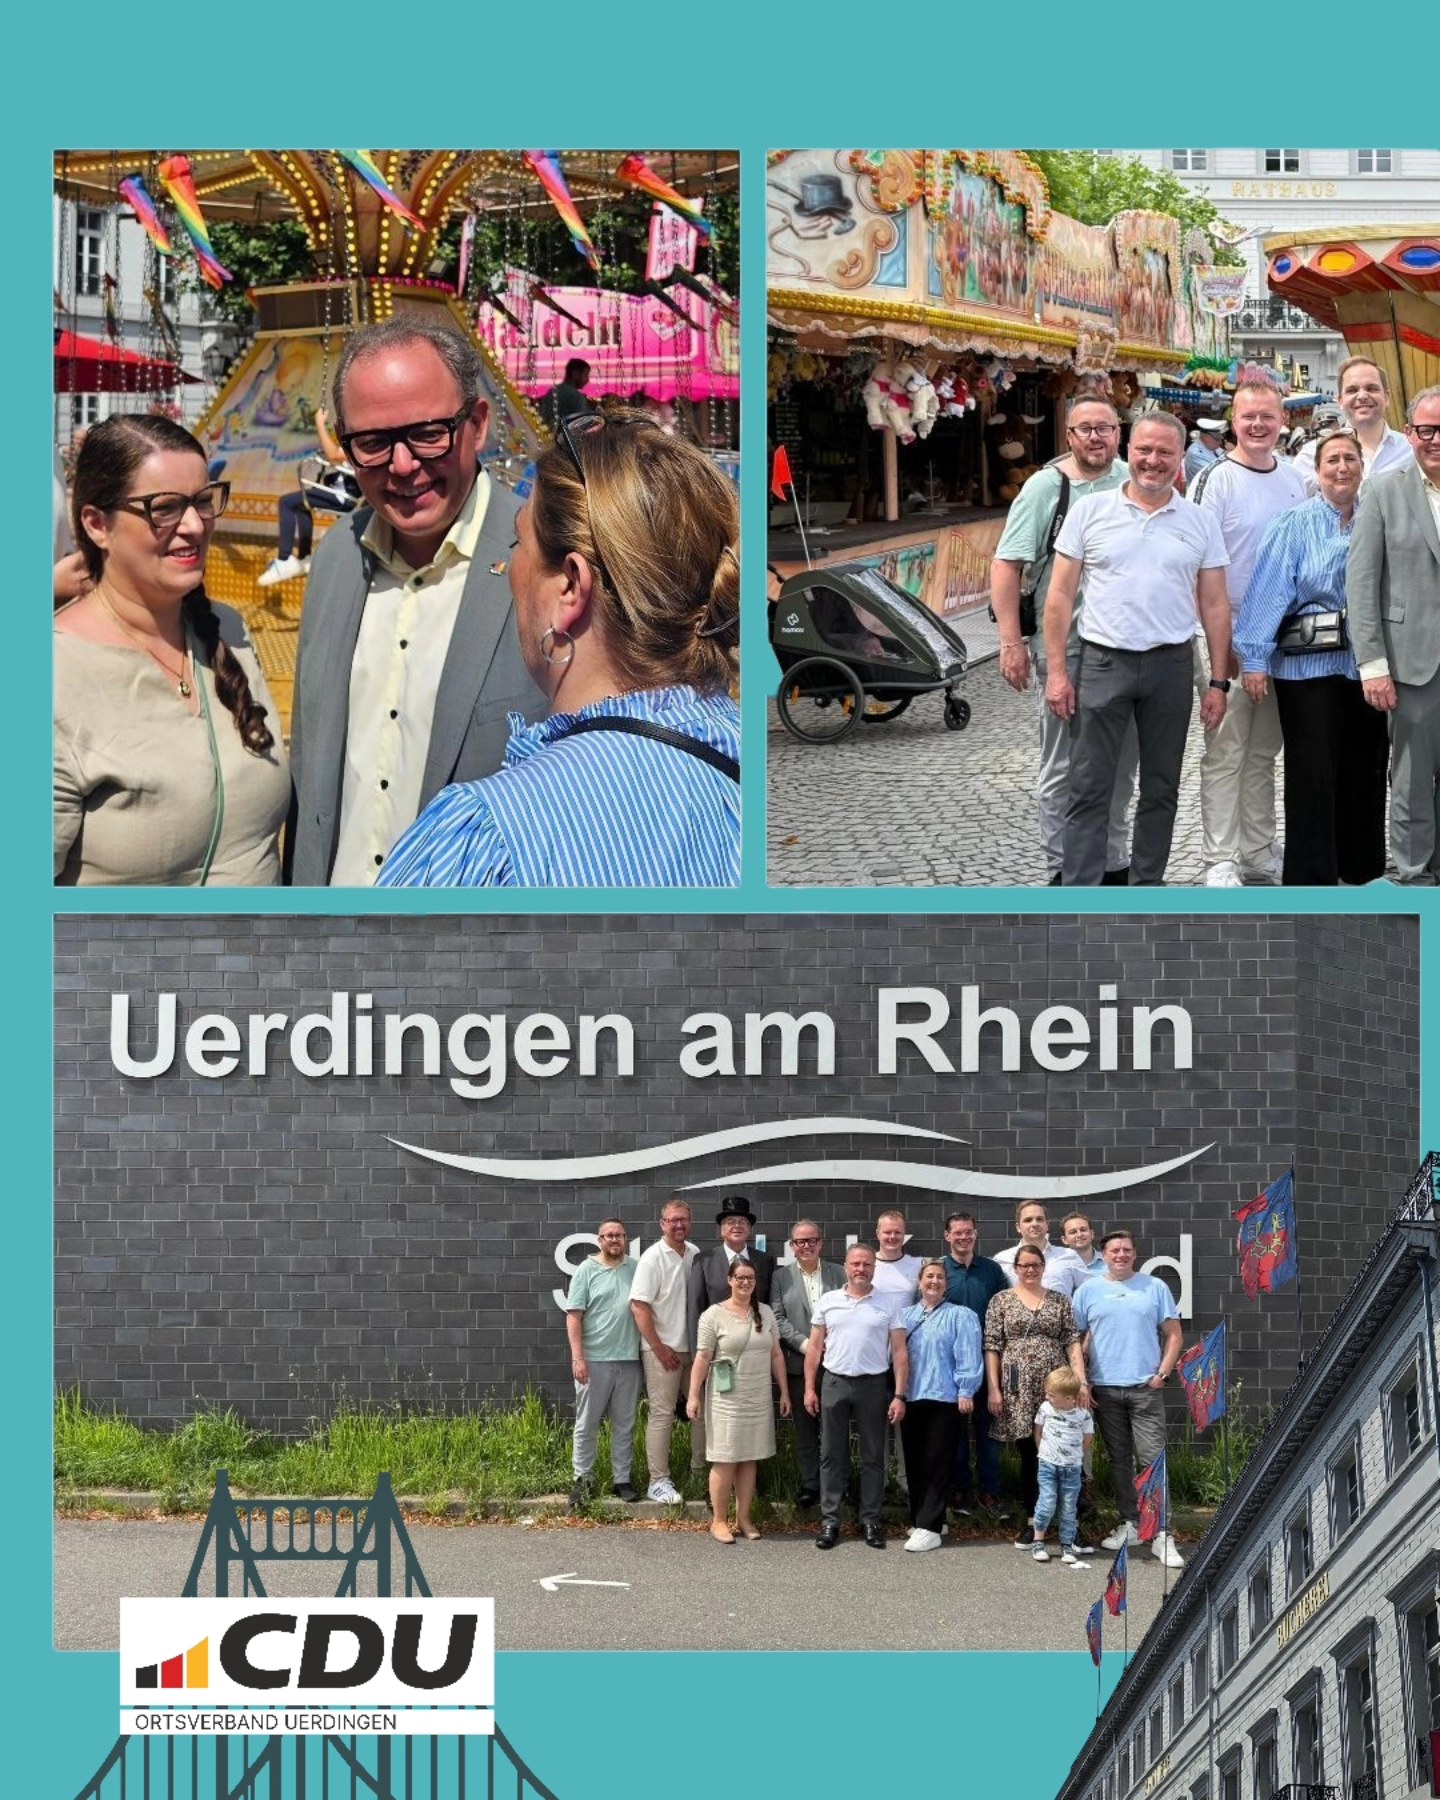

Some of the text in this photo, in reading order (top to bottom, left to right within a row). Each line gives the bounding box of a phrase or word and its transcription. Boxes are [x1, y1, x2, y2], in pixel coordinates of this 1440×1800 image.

[1231, 181, 1337, 198] RATHAUS
[110, 984, 1194, 1100] Uerdingen am Rhein
